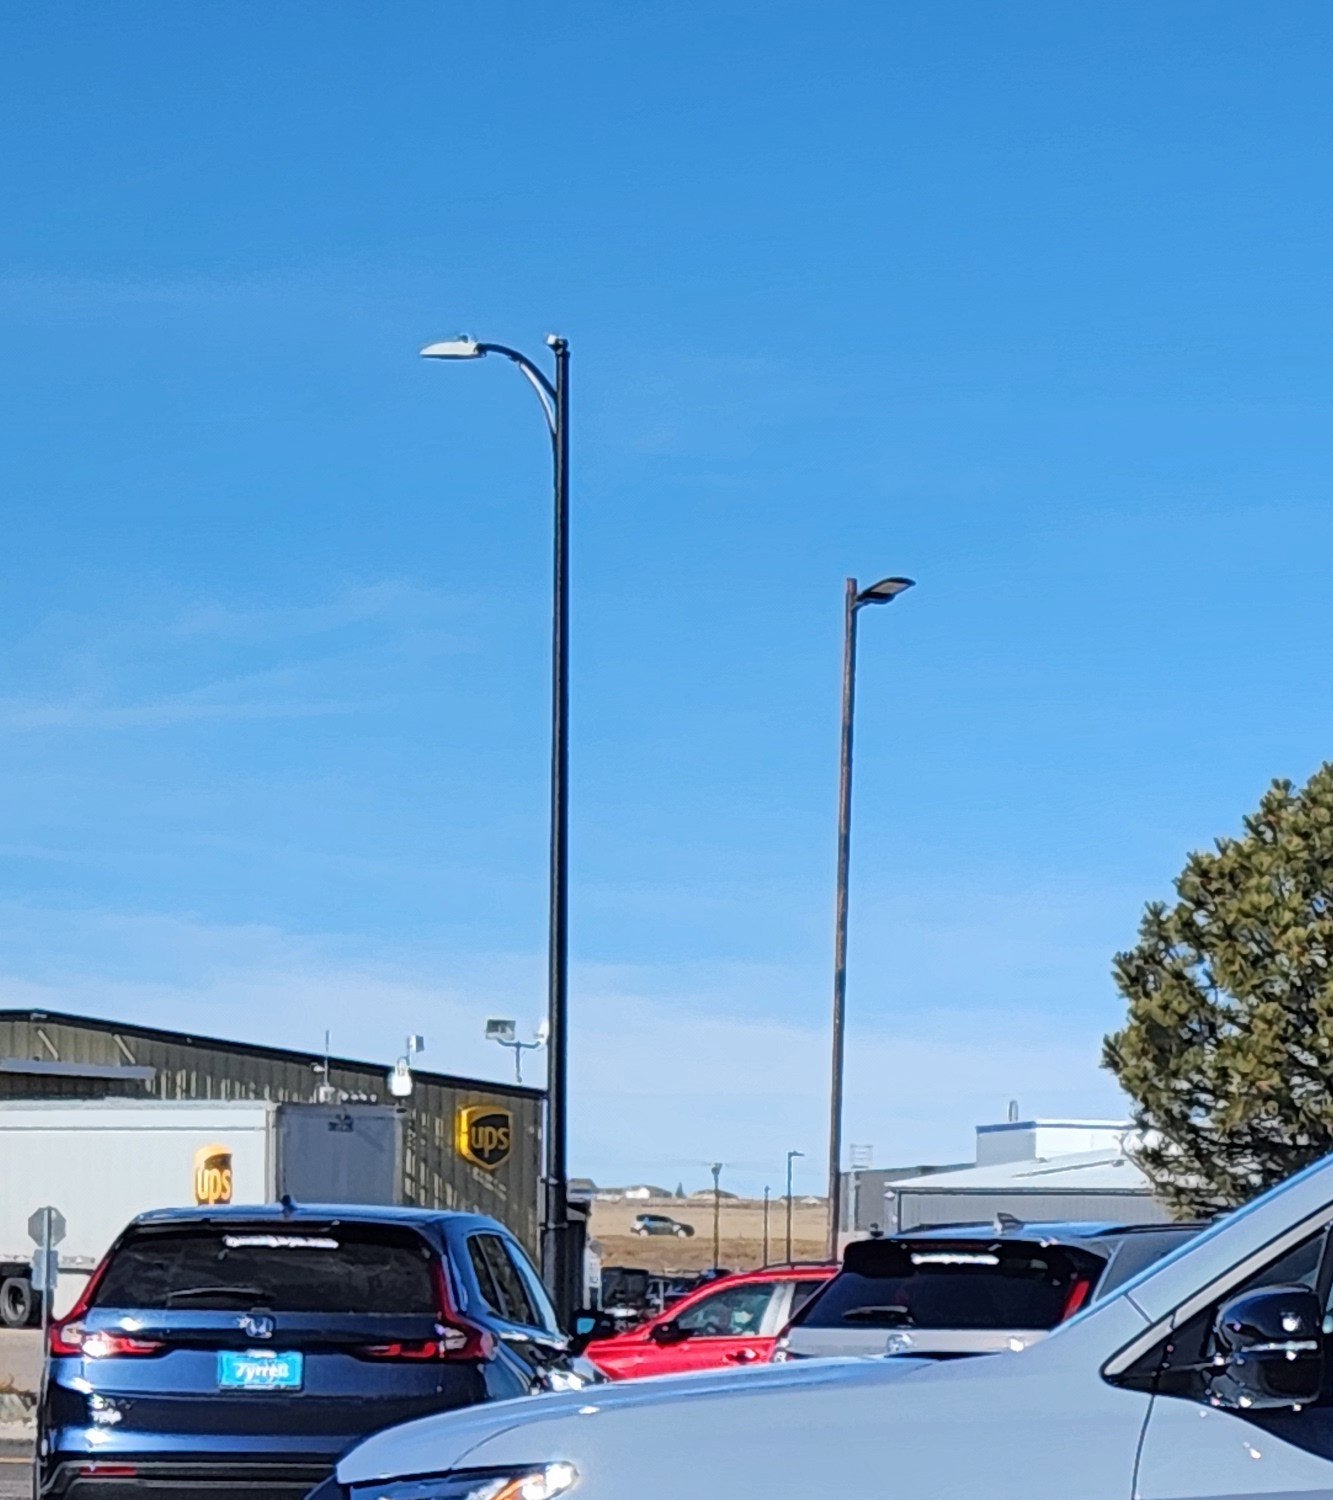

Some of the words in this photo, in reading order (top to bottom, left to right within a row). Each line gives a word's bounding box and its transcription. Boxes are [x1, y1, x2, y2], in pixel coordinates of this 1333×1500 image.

[471, 1126, 510, 1158] ups
[197, 1167, 231, 1205] ups
[232, 1362, 290, 1382] Tyrrell
